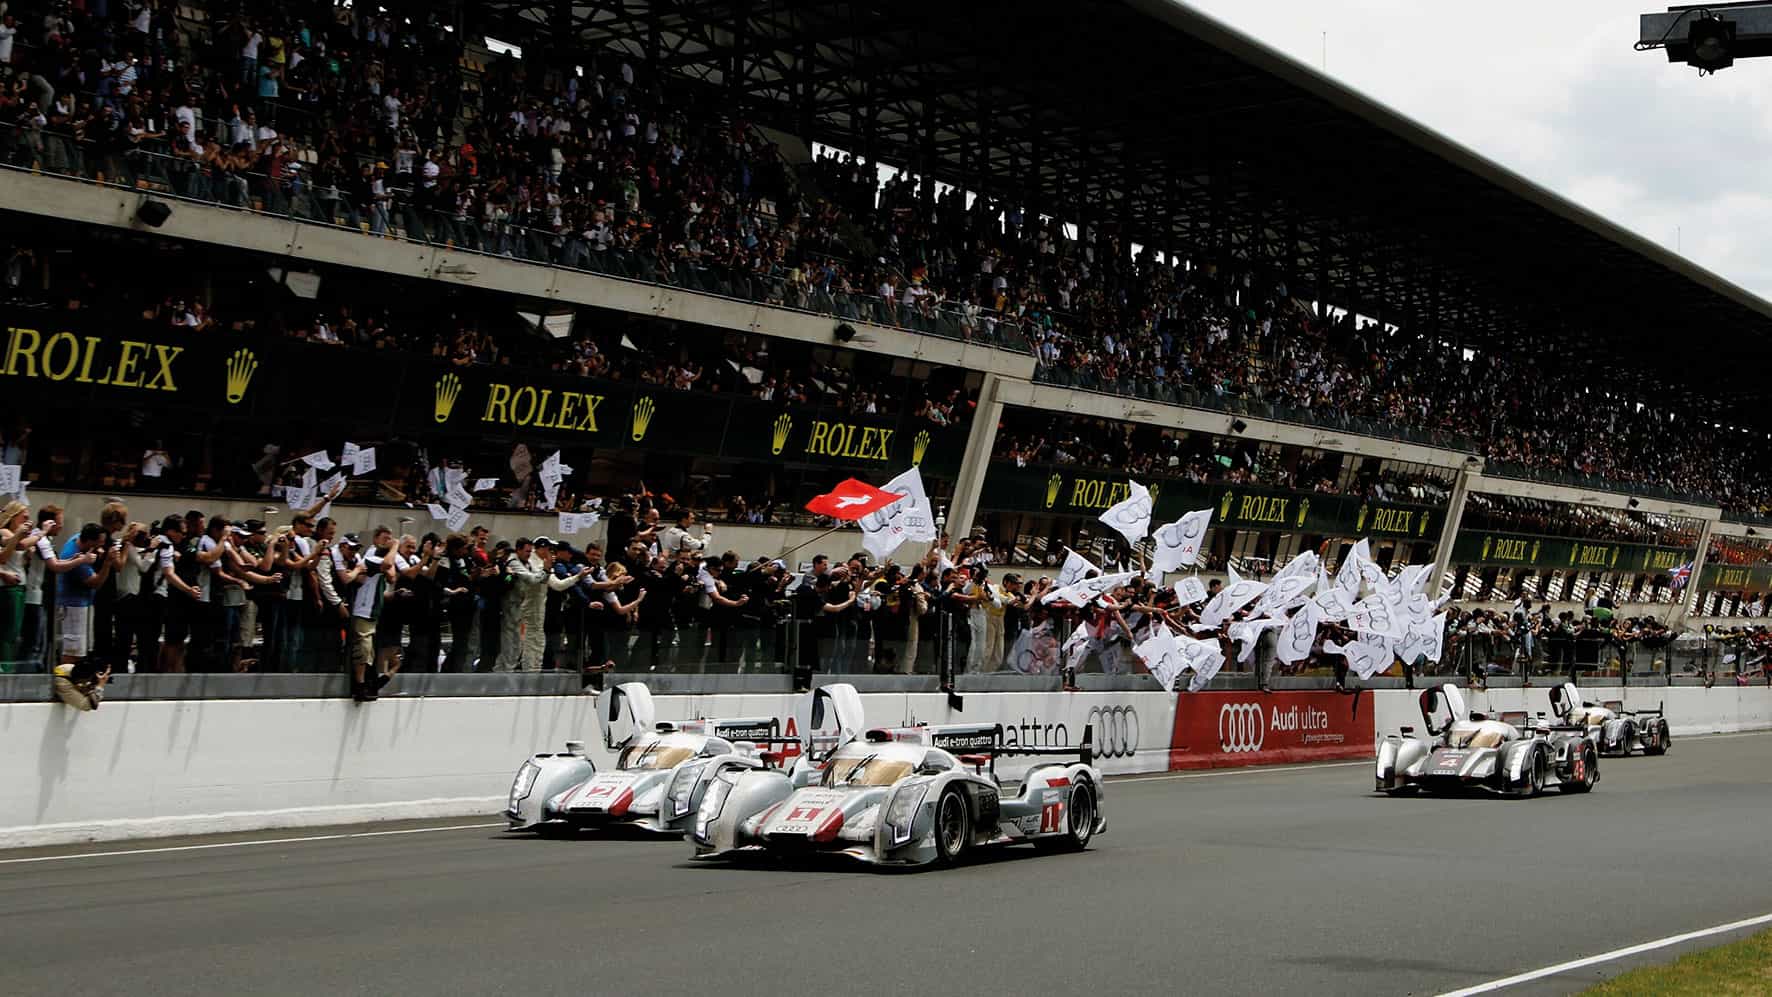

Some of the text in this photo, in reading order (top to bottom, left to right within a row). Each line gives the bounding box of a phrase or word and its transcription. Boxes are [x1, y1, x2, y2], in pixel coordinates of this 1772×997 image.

[0, 327, 184, 392] ROLEX
[481, 383, 604, 432] ROLEX
[804, 420, 894, 461] ROLEX
[1237, 495, 1289, 523] ROLEX
[1373, 507, 1413, 533] ROLEX
[1494, 539, 1528, 561] ROLEX
[1271, 705, 1328, 731] Audi ultra
[716, 727, 730, 738] Audi
[935, 736, 949, 748] Audi
[950, 736, 969, 748] e-tron
[969, 735, 993, 748] quattro
[1044, 806, 1055, 833] 1
